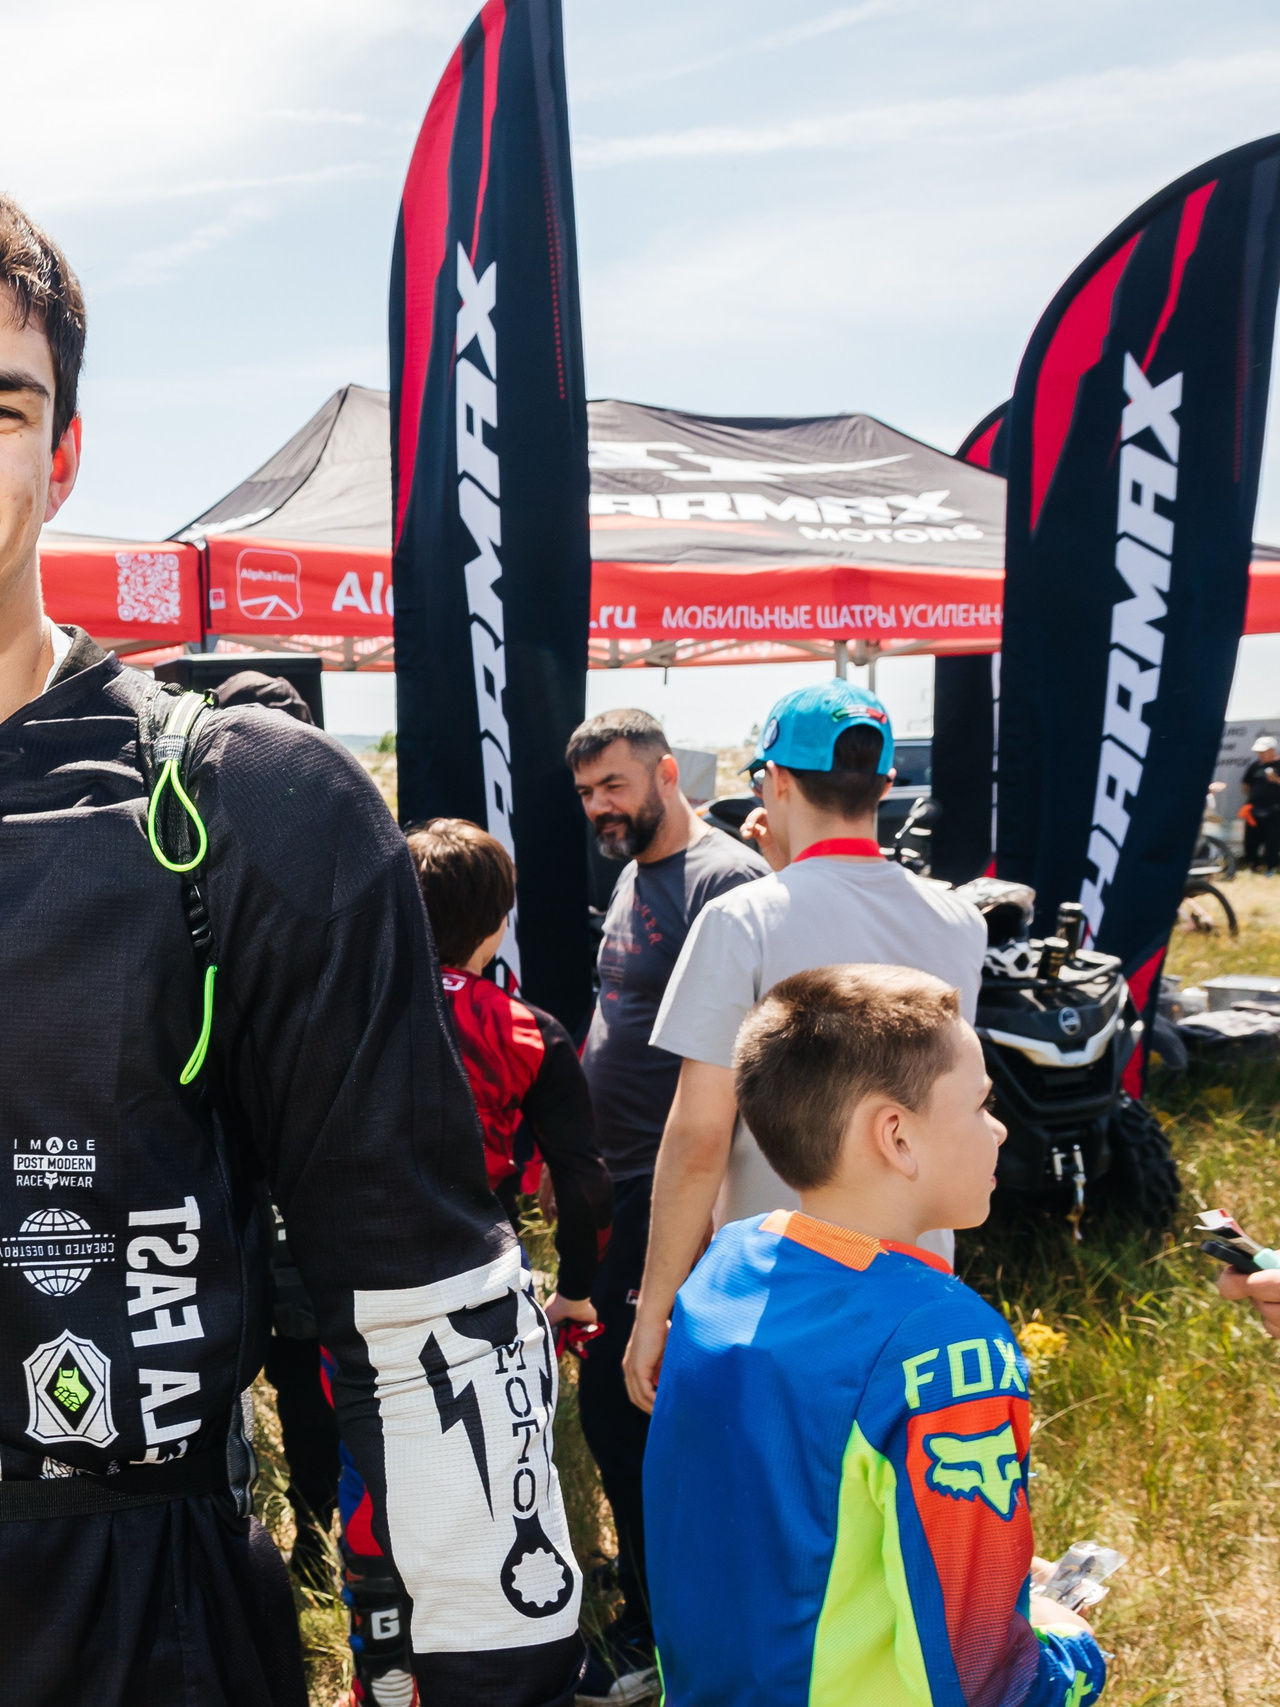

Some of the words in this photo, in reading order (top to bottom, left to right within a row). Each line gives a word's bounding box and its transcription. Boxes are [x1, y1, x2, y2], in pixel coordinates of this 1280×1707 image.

[589, 490, 963, 525] ARMAX
[798, 524, 984, 543] MOTORS
[240, 568, 296, 583] AlphaTent
[456, 241, 521, 996] ARMAX
[662, 604, 813, 630] МОБИЛЬНЫЕ
[816, 604, 898, 629] ШАТРЫ
[899, 602, 1003, 628] УСИЛЕНН
[1081, 352, 1183, 950] HARMAX
[13, 1136, 96, 1154] IMAGE
[16, 1156, 45, 1169] POST
[47, 1157, 93, 1171] MODERN
[16, 1174, 44, 1187] RACE
[59, 1175, 93, 1188] WEAR
[47, 1244, 61, 1256] TO
[65, 1242, 115, 1255] CREATED
[902, 1337, 1026, 1409] FOX
[495, 1339, 539, 1513] MOTO
[371, 1608, 400, 1640] G
